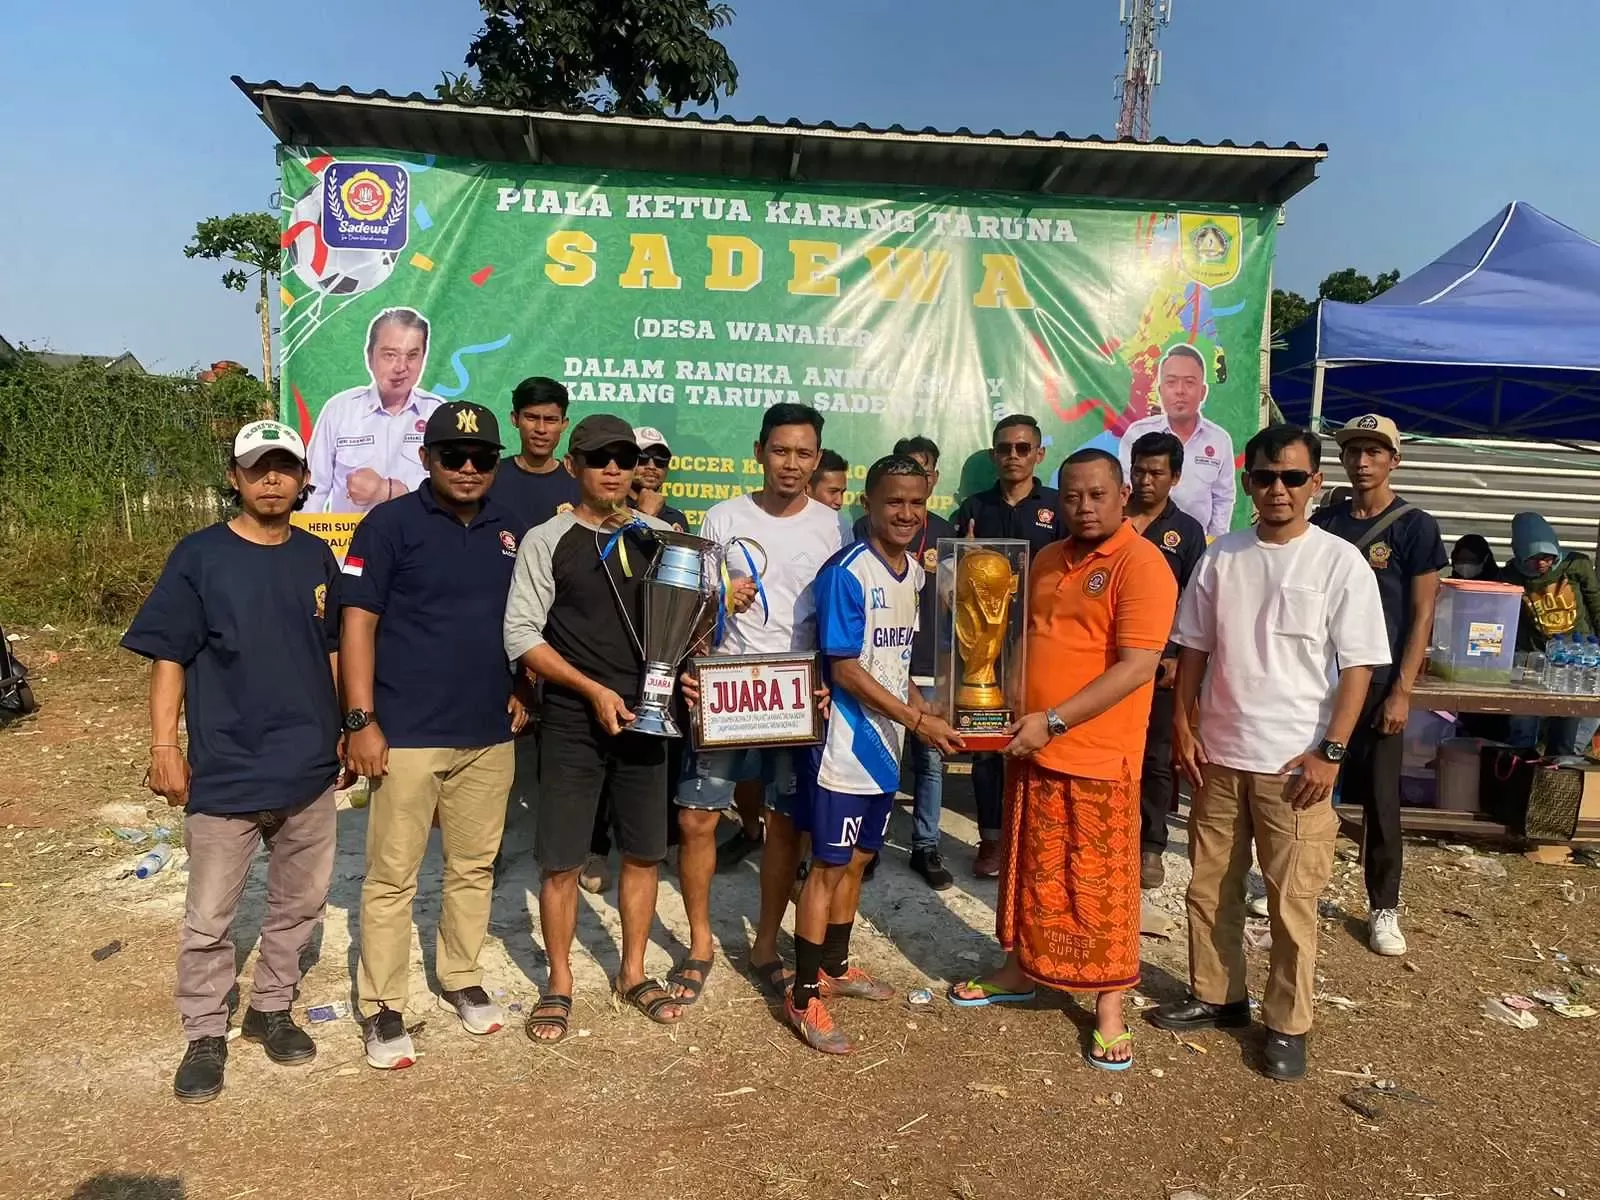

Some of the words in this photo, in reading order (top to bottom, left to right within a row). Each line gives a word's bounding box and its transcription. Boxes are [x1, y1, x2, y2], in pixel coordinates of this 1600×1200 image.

[496, 187, 612, 217] PIALA
[626, 195, 751, 222] KETUA
[765, 200, 915, 233] KARANG
[928, 211, 1077, 242] TARUNA
[338, 221, 389, 234] Sadewa
[544, 230, 1035, 310] SADEWA
[634, 316, 715, 340] (DESA
[564, 357, 664, 379] DALAM
[675, 360, 792, 384] RANGKA
[560, 381, 674, 404] KARANG
[667, 455, 735, 473] OCCER
[308, 522, 332, 532] HERI
[647, 677, 671, 688] JUARA
[710, 678, 784, 713] JUARA
[791, 677, 805, 710] 1
[1048, 942, 1090, 960] SUPER
